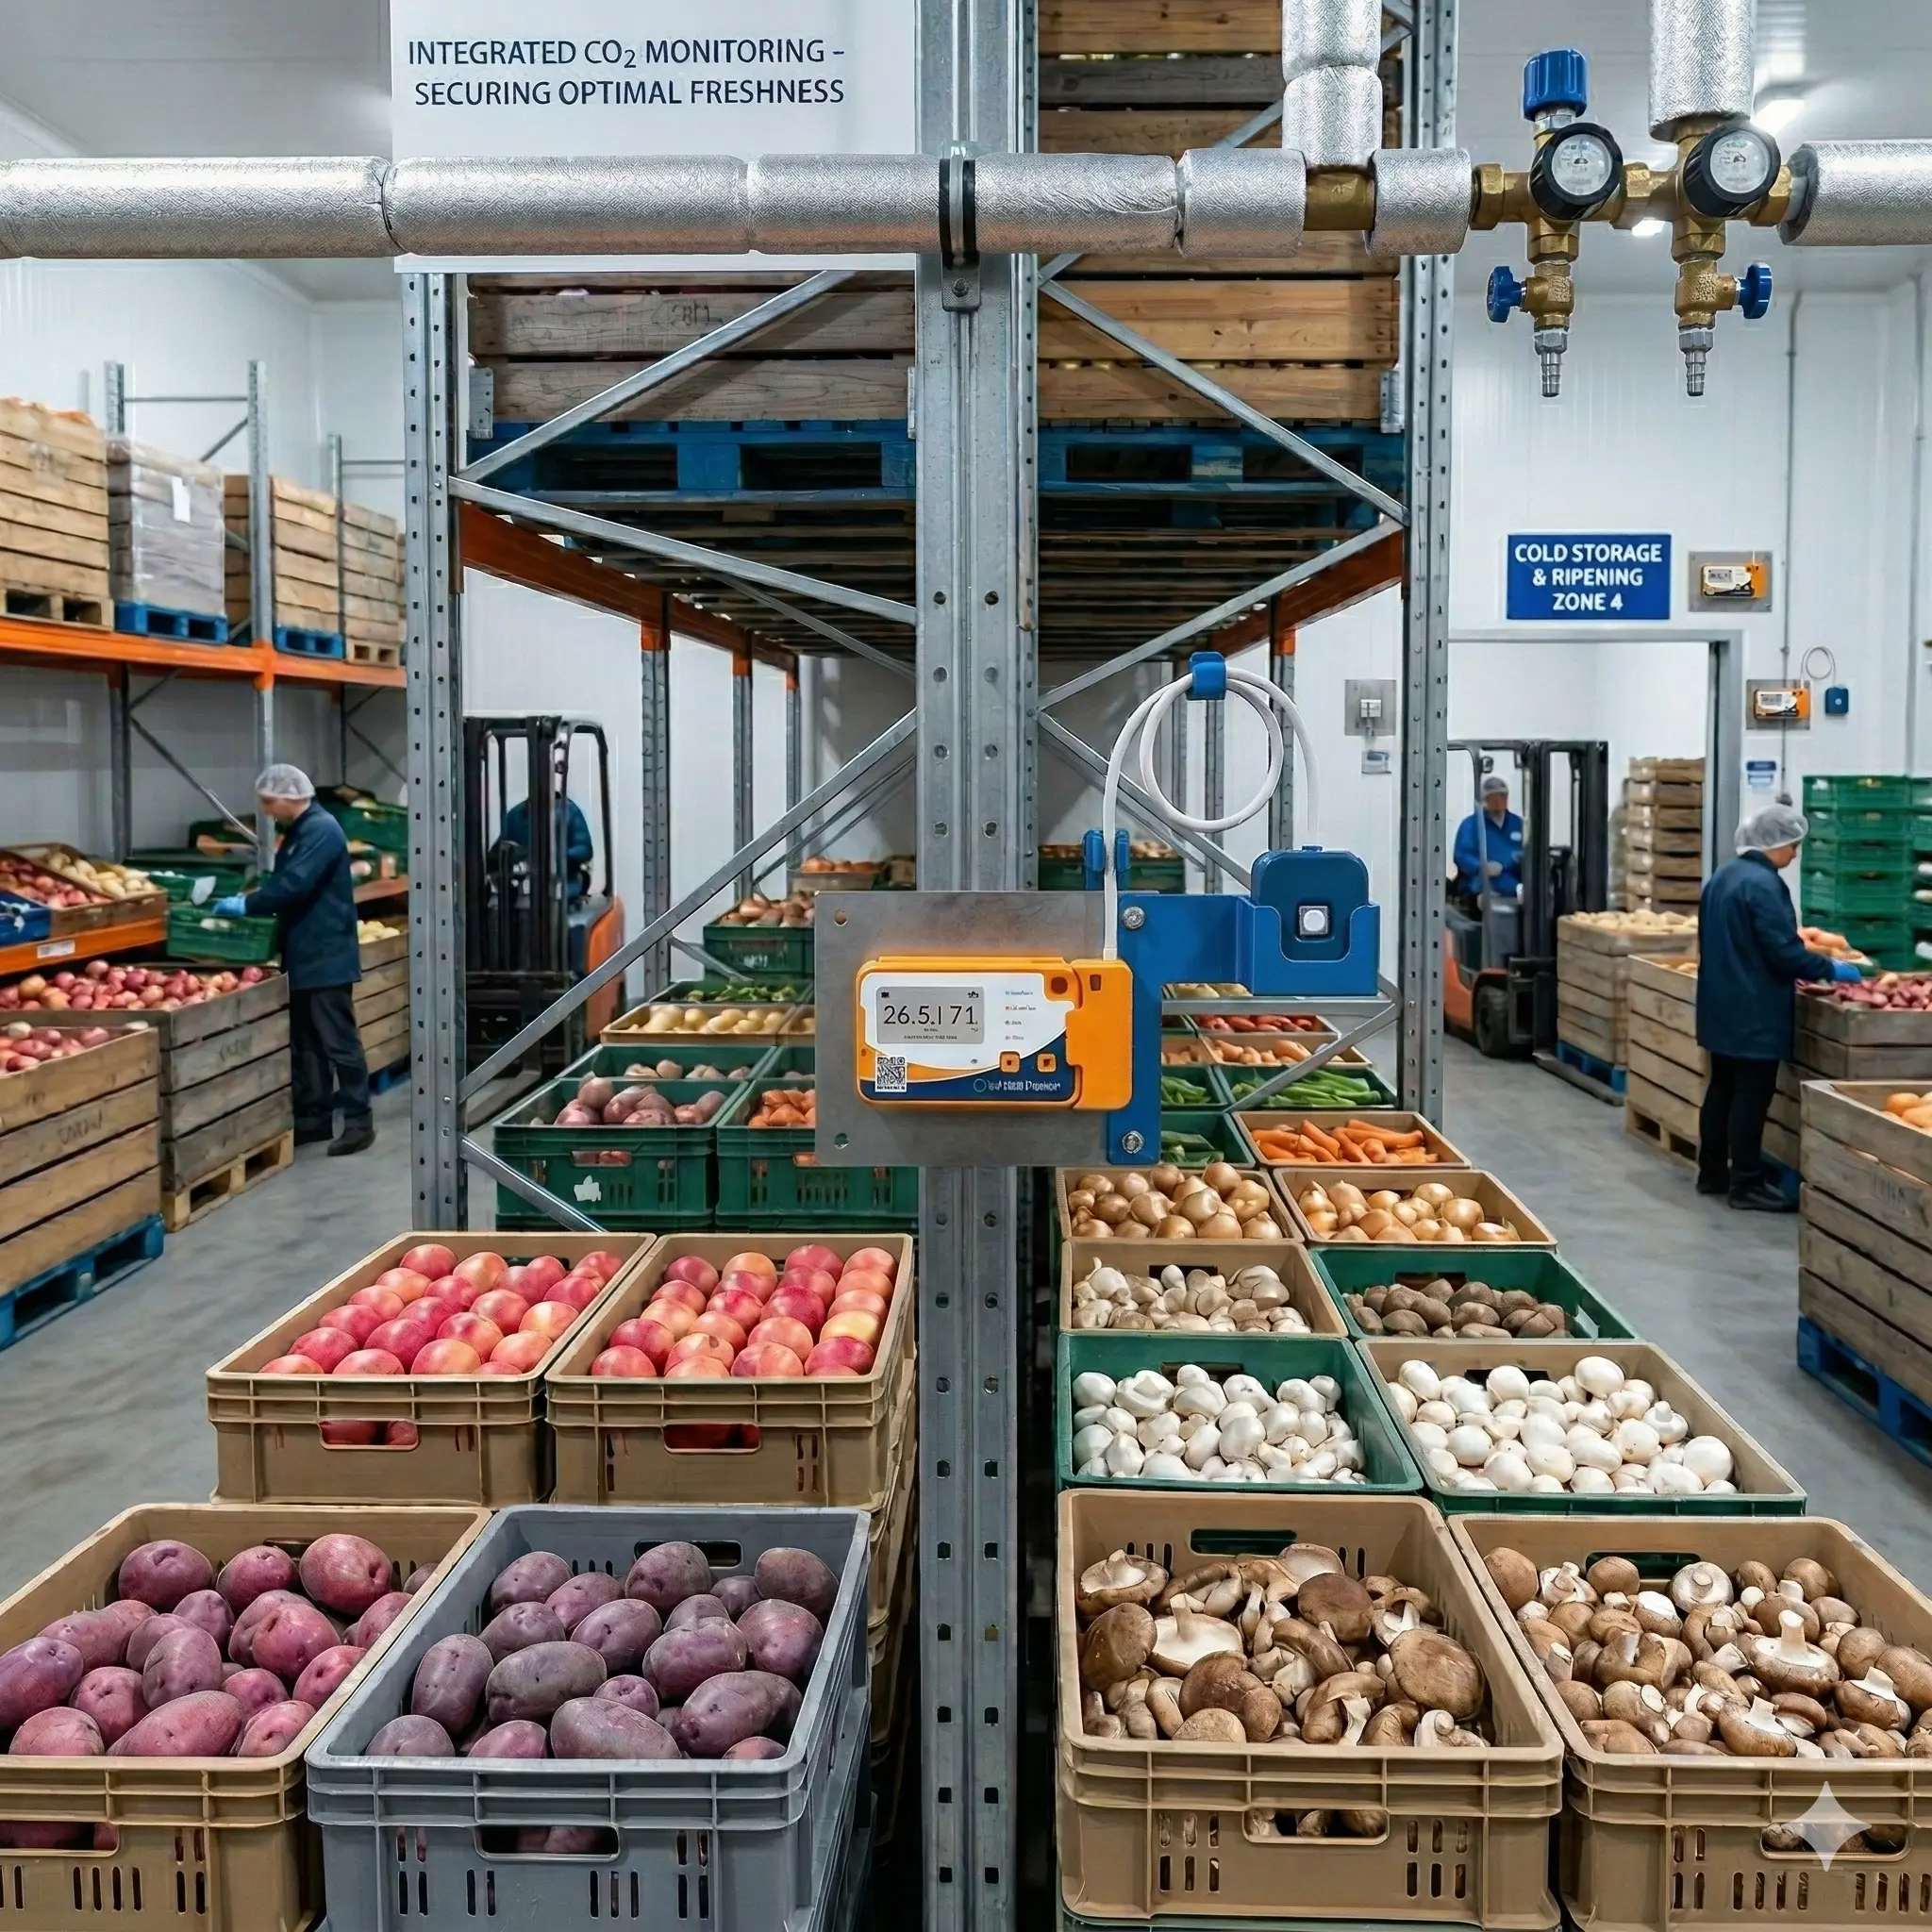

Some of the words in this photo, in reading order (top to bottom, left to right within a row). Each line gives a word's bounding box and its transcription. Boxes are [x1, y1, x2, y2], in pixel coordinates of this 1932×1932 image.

[408, 40, 576, 65] INTEGRATED
[645, 38, 824, 64] MONITORING
[415, 81, 551, 106] SECURING
[558, 80, 683, 106] OPTIMAL
[691, 78, 844, 104] FRESHNESS
[1514, 543, 1568, 562] COLD
[1572, 543, 1662, 563] STORAGE
[1532, 568, 1547, 587] &
[1552, 567, 1643, 587] RIPENING
[1552, 591, 1607, 611] ZONE
[1609, 592, 1624, 610] 4
